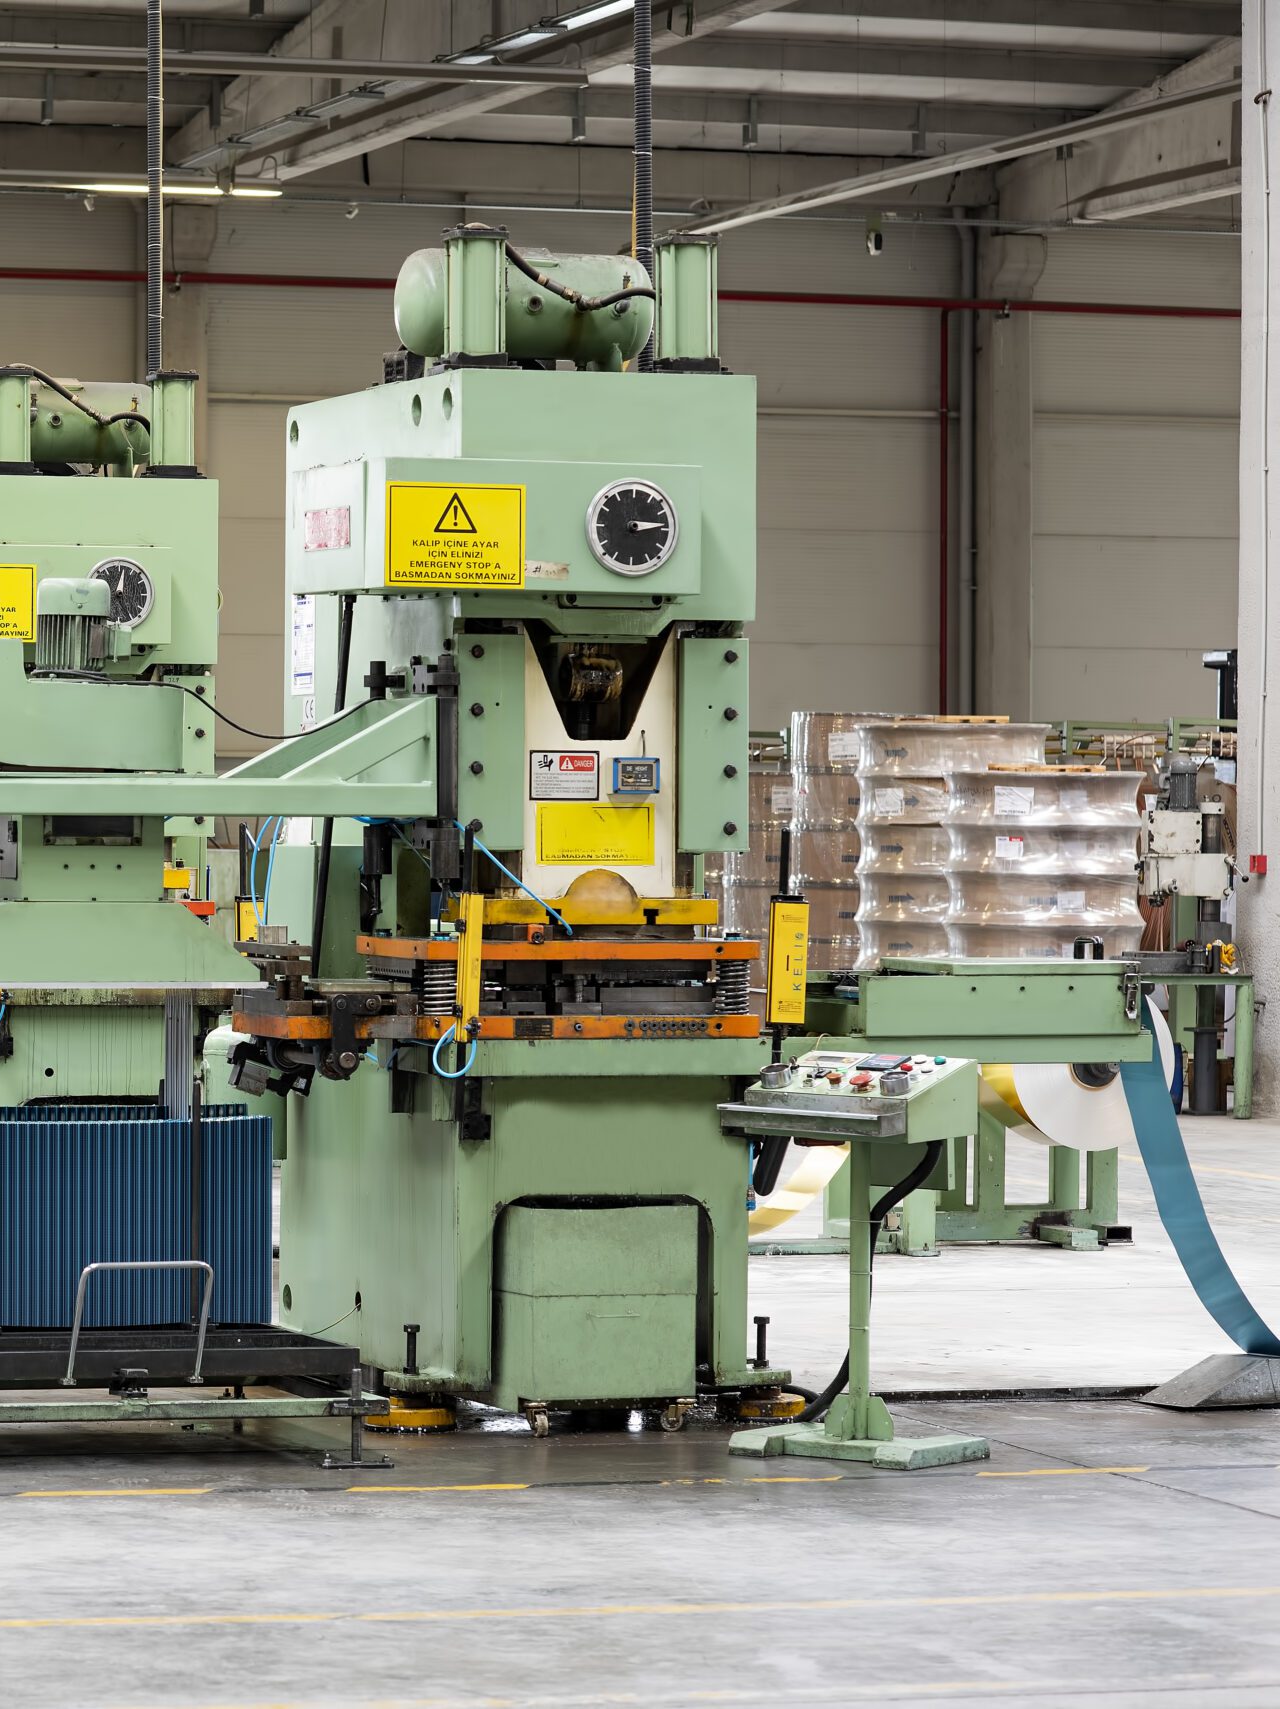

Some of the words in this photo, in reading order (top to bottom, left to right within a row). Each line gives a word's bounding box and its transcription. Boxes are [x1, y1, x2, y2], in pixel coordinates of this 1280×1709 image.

[412, 539, 441, 547] KALIP
[471, 541, 499, 549] AYAR
[409, 560, 463, 569] EMERGENY
[394, 570, 452, 579] BASMADAN
[454, 571, 516, 580] SOKMAYINIZ
[573, 760, 593, 768] DANGER
